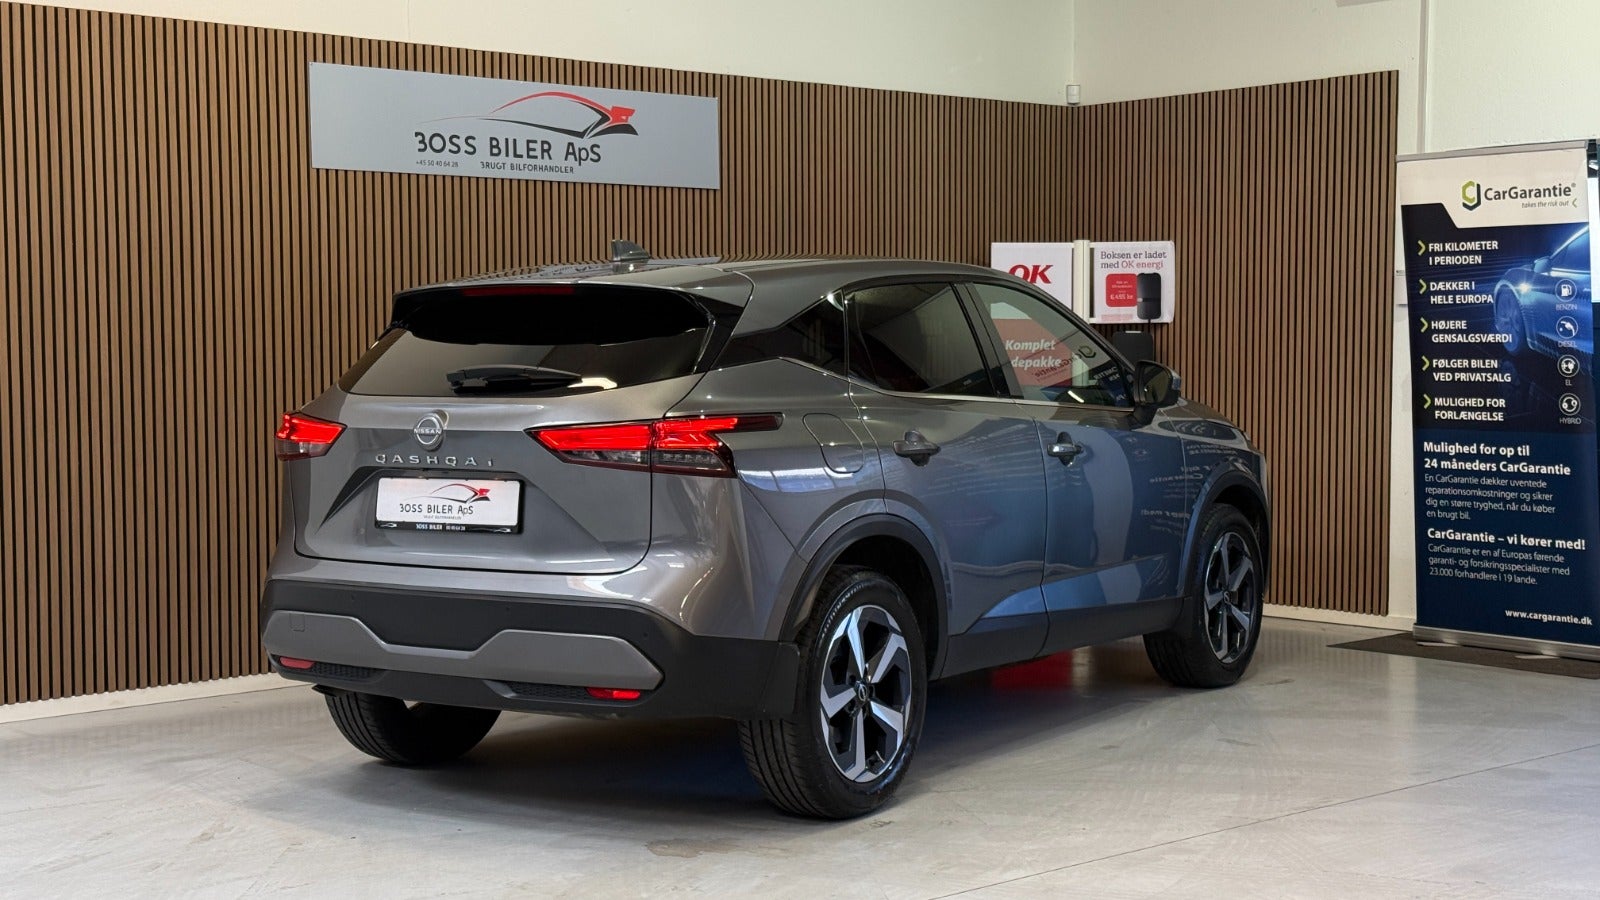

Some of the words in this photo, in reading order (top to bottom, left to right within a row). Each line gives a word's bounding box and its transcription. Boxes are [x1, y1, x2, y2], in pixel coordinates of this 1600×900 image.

[415, 131, 477, 155] BOSS
[490, 135, 552, 161] BILER
[565, 141, 601, 166] ApS
[480, 161, 507, 170] BRUGT
[510, 163, 574, 174] BILFORHANDLER
[1522, 201, 1537, 209] takes
[1538, 200, 1547, 208] the
[1428, 242, 1443, 252] FRI
[1445, 240, 1498, 252] KILOMETER
[1100, 250, 1132, 260] Boksen
[1133, 252, 1143, 260] er
[1144, 251, 1167, 260] ladet
[1429, 257, 1432, 266] I
[1434, 255, 1482, 266] PERIODEN
[1100, 260, 1120, 269] med
[1121, 260, 1134, 268] OK
[1136, 260, 1164, 270] energi
[1008, 265, 1053, 284] OK
[1430, 281, 1470, 291] DÆKKER
[1430, 295, 1454, 304] HELE
[1456, 294, 1494, 304] EUROPA
[1431, 320, 1467, 330] HØJERE
[1431, 334, 1513, 343] GENSALGSVÆRDI
[1558, 340, 1578, 348] DIESEL
[1005, 339, 1056, 353] Komplet
[1011, 355, 1062, 371] depakke
[1432, 358, 1470, 368] FØLGER
[1471, 359, 1498, 368] BILEN
[1433, 372, 1453, 382] VED
[1454, 372, 1512, 383] PRIVATSALG
[1434, 398, 1484, 408] MULIGHED
[1486, 398, 1506, 408] FOR
[1434, 410, 1504, 421] FORLÆNGELSE
[1424, 442, 1477, 456] Mulighed
[1480, 444, 1496, 454] for
[1499, 447, 1515, 458] op
[1518, 445, 1530, 456] til
[1424, 458, 1438, 468] 24
[1440, 458, 1497, 472] måneders
[1500, 462, 1571, 476] CarGarantie
[1424, 474, 1434, 482] En
[1436, 474, 1479, 484] CarGarantie
[1480, 476, 1508, 486] dækker
[1510, 478, 1547, 488] uventede
[1425, 486, 1518, 500] reparationsomkostninger
[1520, 493, 1530, 502] og
[1532, 492, 1553, 501] sikrer
[400, 503, 423, 513] BOSS
[427, 504, 453, 514] BILER
[458, 506, 474, 516] ApS
[1426, 498, 1438, 507] dig
[1450, 500, 1472, 508] større
[1474, 500, 1505, 512] tryghed,
[1506, 502, 1519, 512] når
[1520, 503, 1532, 512] du
[1533, 504, 1556, 514] køber
[1438, 510, 1458, 520] brugt
[1460, 511, 1471, 520] bil.
[1427, 528, 1496, 543] CarGarantie
[1506, 534, 1518, 545] vi
[1520, 536, 1552, 548] kører
[1555, 539, 1586, 550] med!
[1428, 544, 1471, 555] CarGarantie
[1492, 548, 1500, 557] af
[1501, 550, 1532, 560] Europas
[1534, 552, 1564, 563] førende
[1428, 556, 1457, 566] garanti-
[1458, 560, 1468, 568] og
[1470, 560, 1550, 574] forsikringsspecialister
[1552, 566, 1570, 576] med
[1430, 567, 1454, 576] 23.000
[1454, 569, 1498, 582] forhandlere
[1503, 574, 1512, 582] 19
[1514, 574, 1538, 584] lande.
[1505, 609, 1592, 626] www.cargarantie.dk
